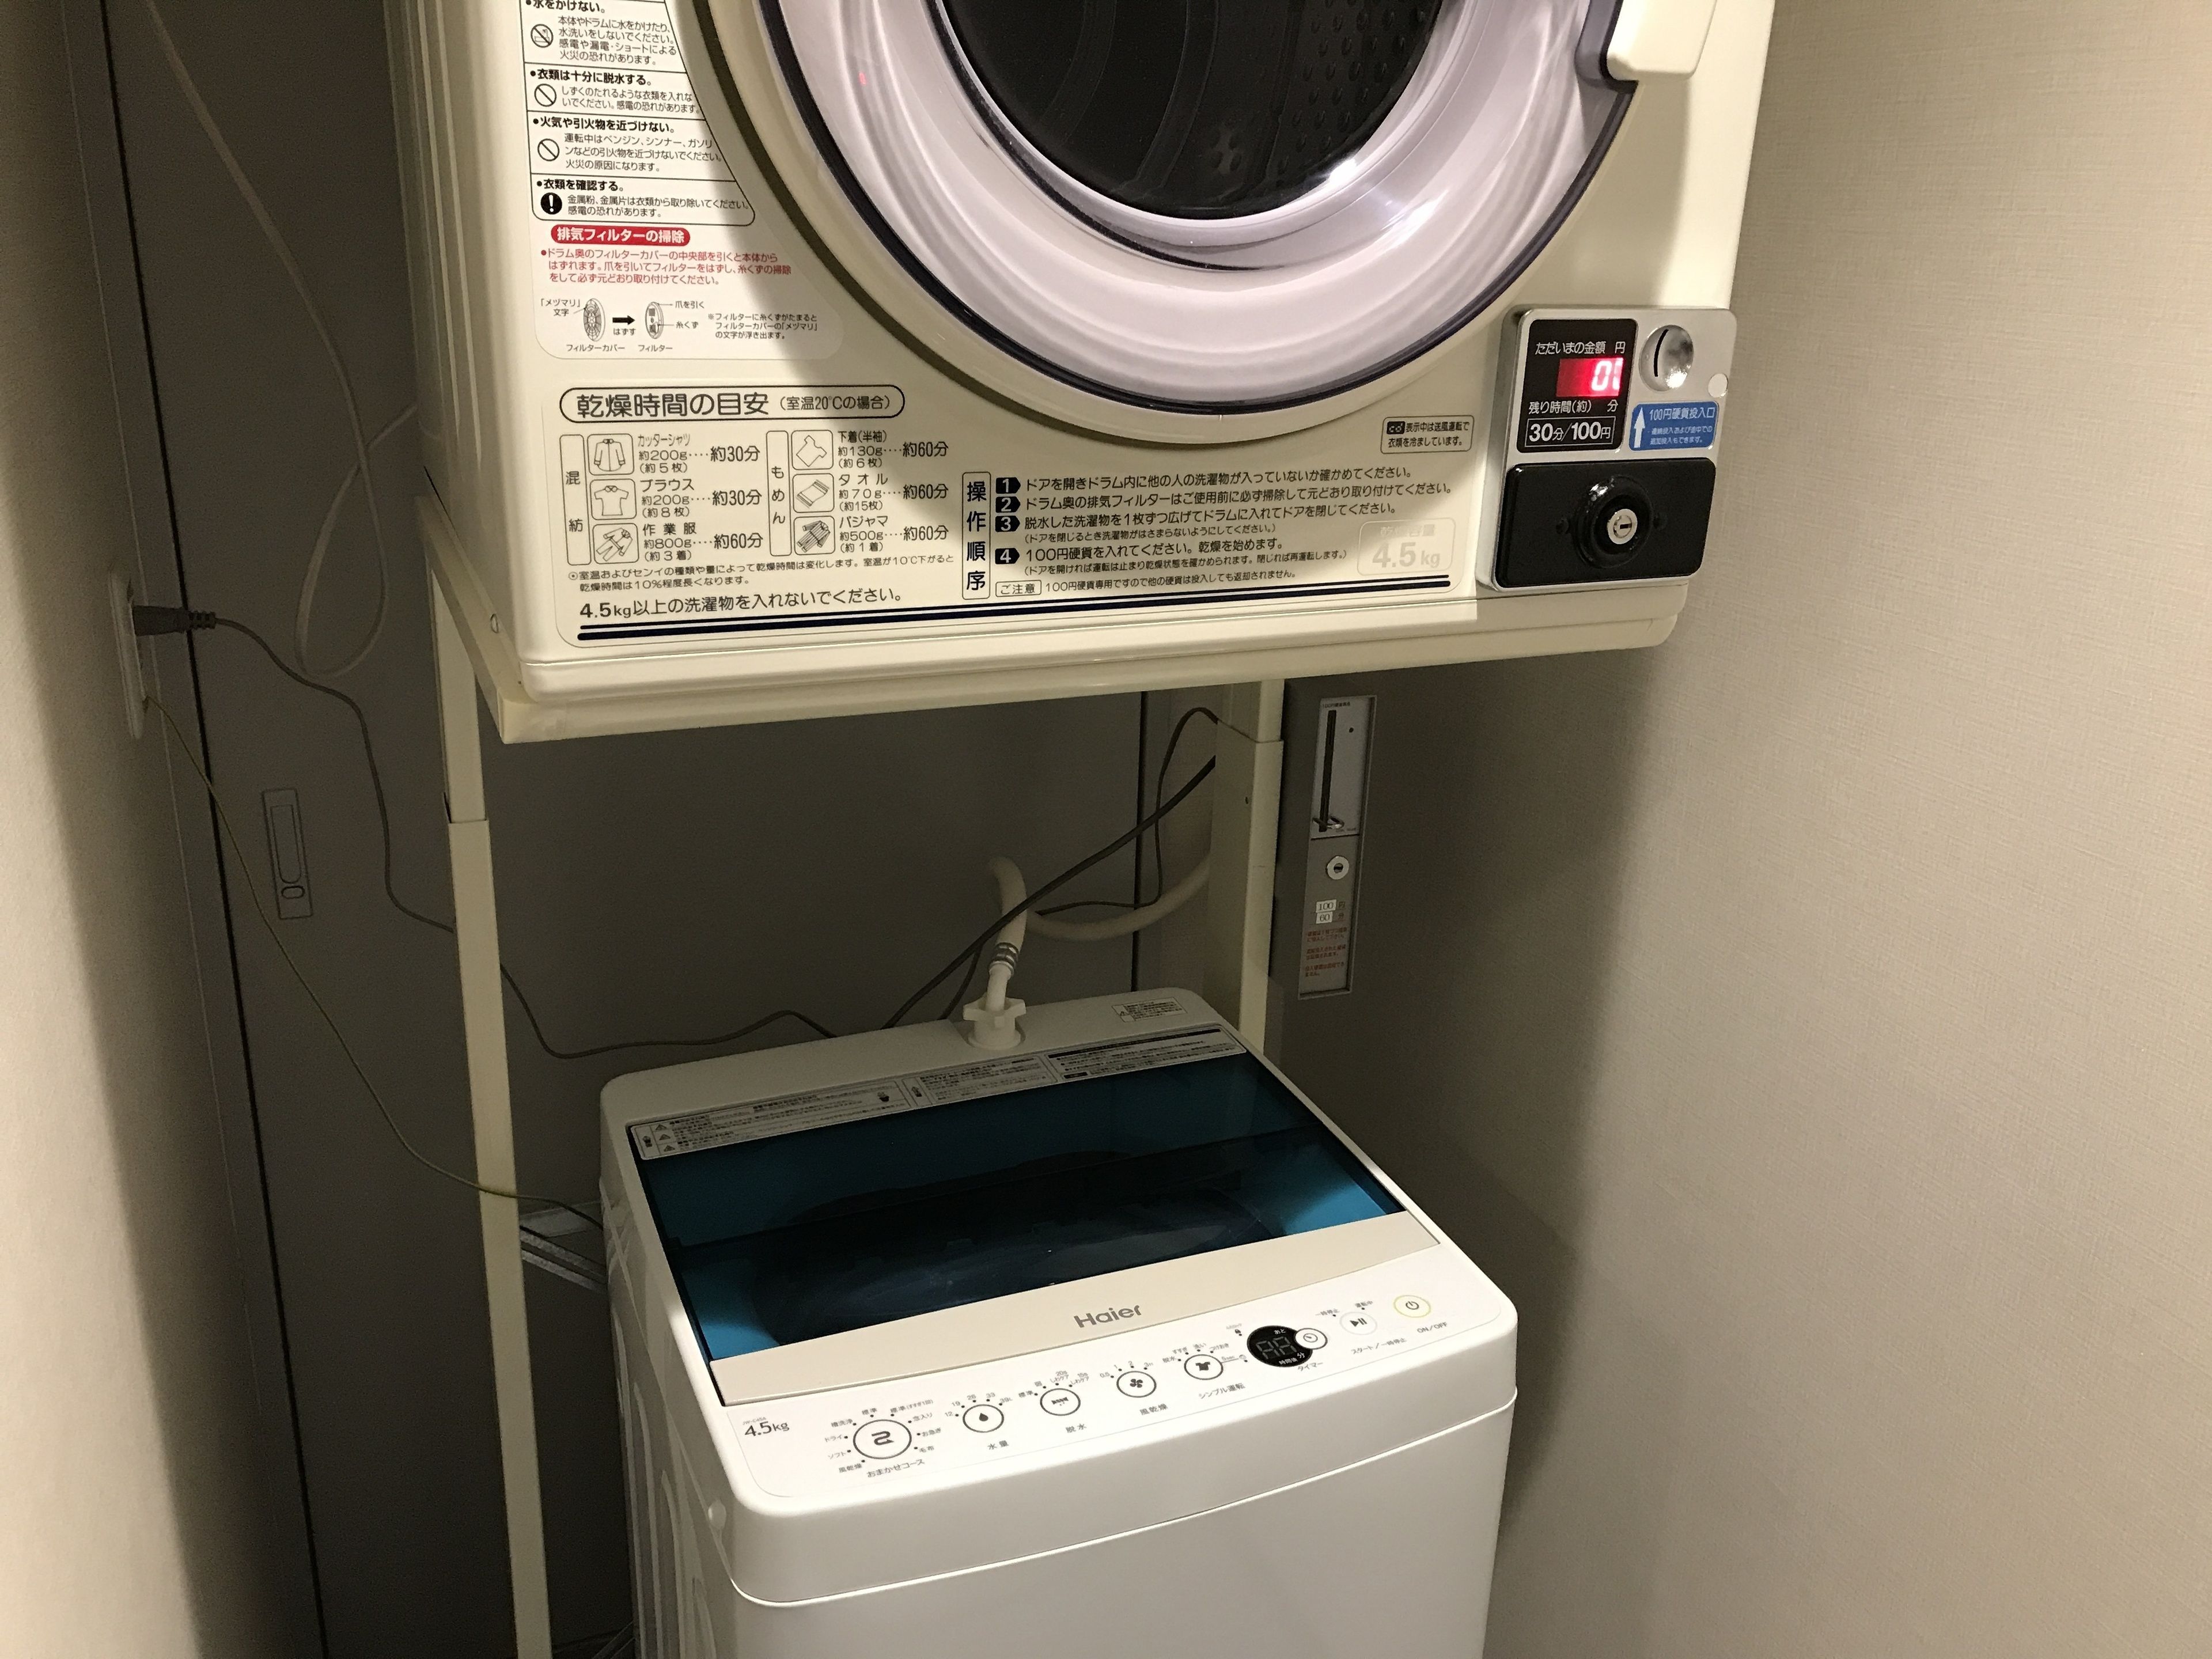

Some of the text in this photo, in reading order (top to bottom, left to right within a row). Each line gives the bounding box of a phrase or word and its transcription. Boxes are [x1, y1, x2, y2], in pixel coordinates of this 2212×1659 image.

[559, 26, 674, 44] 水洗いをしないでください。
[560, 50, 656, 65] 火災の恐れがあります。
[537, 68, 652, 86] 衣類は十分に脱水する。
[562, 86, 693, 103] しずくのたれるような衣類を入れな
[540, 117, 675, 134] 火気や引火物を近づけない。
[565, 159, 660, 172] 火災の原因になります。
[543, 179, 624, 192] 衣類を確認する。
[567, 206, 661, 218] 感電の恐れがあります。
[556, 226, 685, 244] 排気フィルターの掃除
[675, 301, 704, 309] 爪を引く
[553, 309, 569, 317] 文字
[613, 328, 636, 336] はずす
[676, 321, 699, 329] 糸くず
[566, 344, 625, 352] フィルターカバー
[638, 344, 673, 352] フィルター
[1535, 342, 1626, 354] ただいまの金額 円
[577, 392, 769, 418] 乾燥時間の目安
[1528, 399, 1618, 415] 残り時間(約) 分
[637, 433, 691, 447] カッターシャツ
[710, 445, 760, 462] 約30分
[903, 441, 949, 457] 約60分
[640, 479, 695, 493] ブラウス
[903, 483, 949, 500] 約60分
[712, 489, 762, 506] 約30分
[1001, 497, 1012, 512] 2
[839, 516, 889, 528] パジャマ
[1001, 517, 1012, 531] 3
[903, 525, 949, 541] 約60分
[966, 480, 986, 591] 操作順序
[714, 533, 763, 550] 約60分
[999, 549, 1012, 564] 4
[1000, 584, 1035, 595] ご注意
[1319, 902, 1334, 911] 100
[1073, 1305, 1142, 1328] Haier
[1417, 1321, 1448, 1334] ON/OFF
[1297, 1362, 1324, 1371] タイマー
[744, 1421, 790, 1436] 4.5kg
[867, 1459, 925, 1478] おまかせコース
